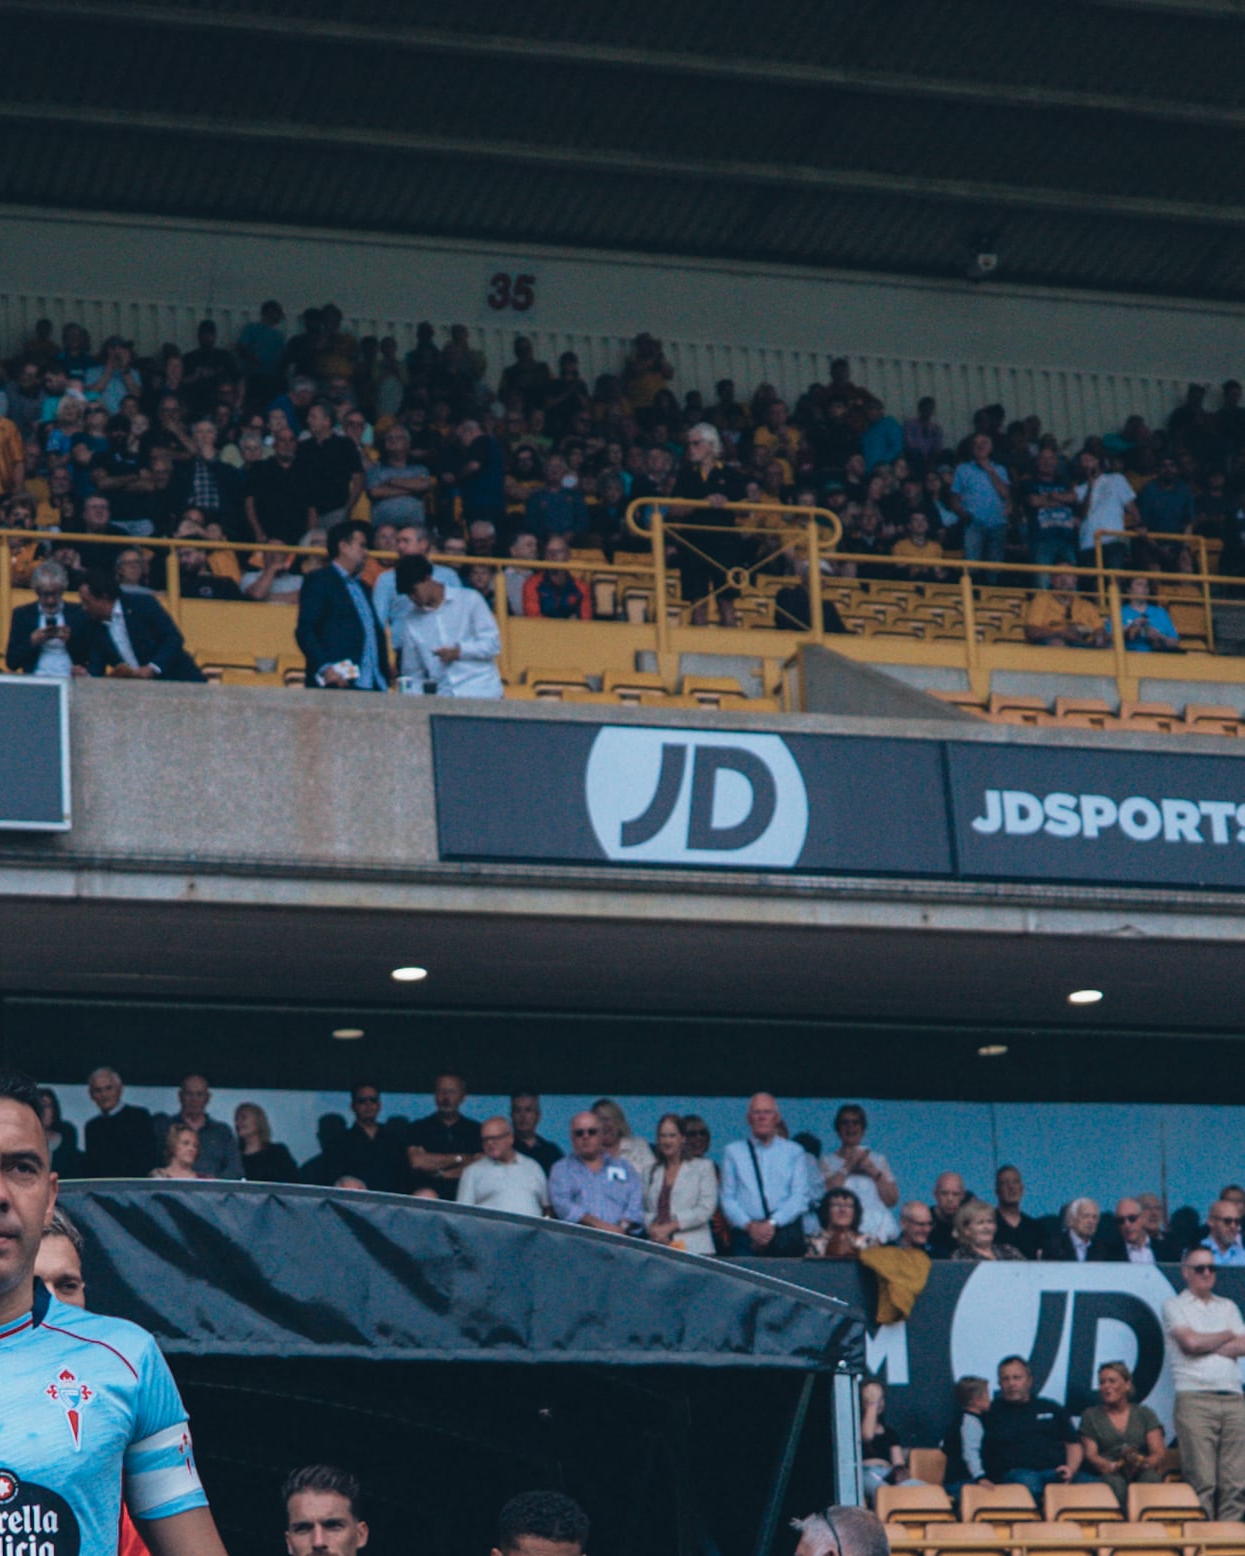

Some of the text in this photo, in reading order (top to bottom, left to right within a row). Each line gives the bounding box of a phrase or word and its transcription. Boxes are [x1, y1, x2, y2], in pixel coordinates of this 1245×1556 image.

[487, 272, 536, 311] 35
[621, 742, 777, 851] JD
[970, 789, 1245, 846] JDSPORT
[991, 1290, 1165, 1416] JD
